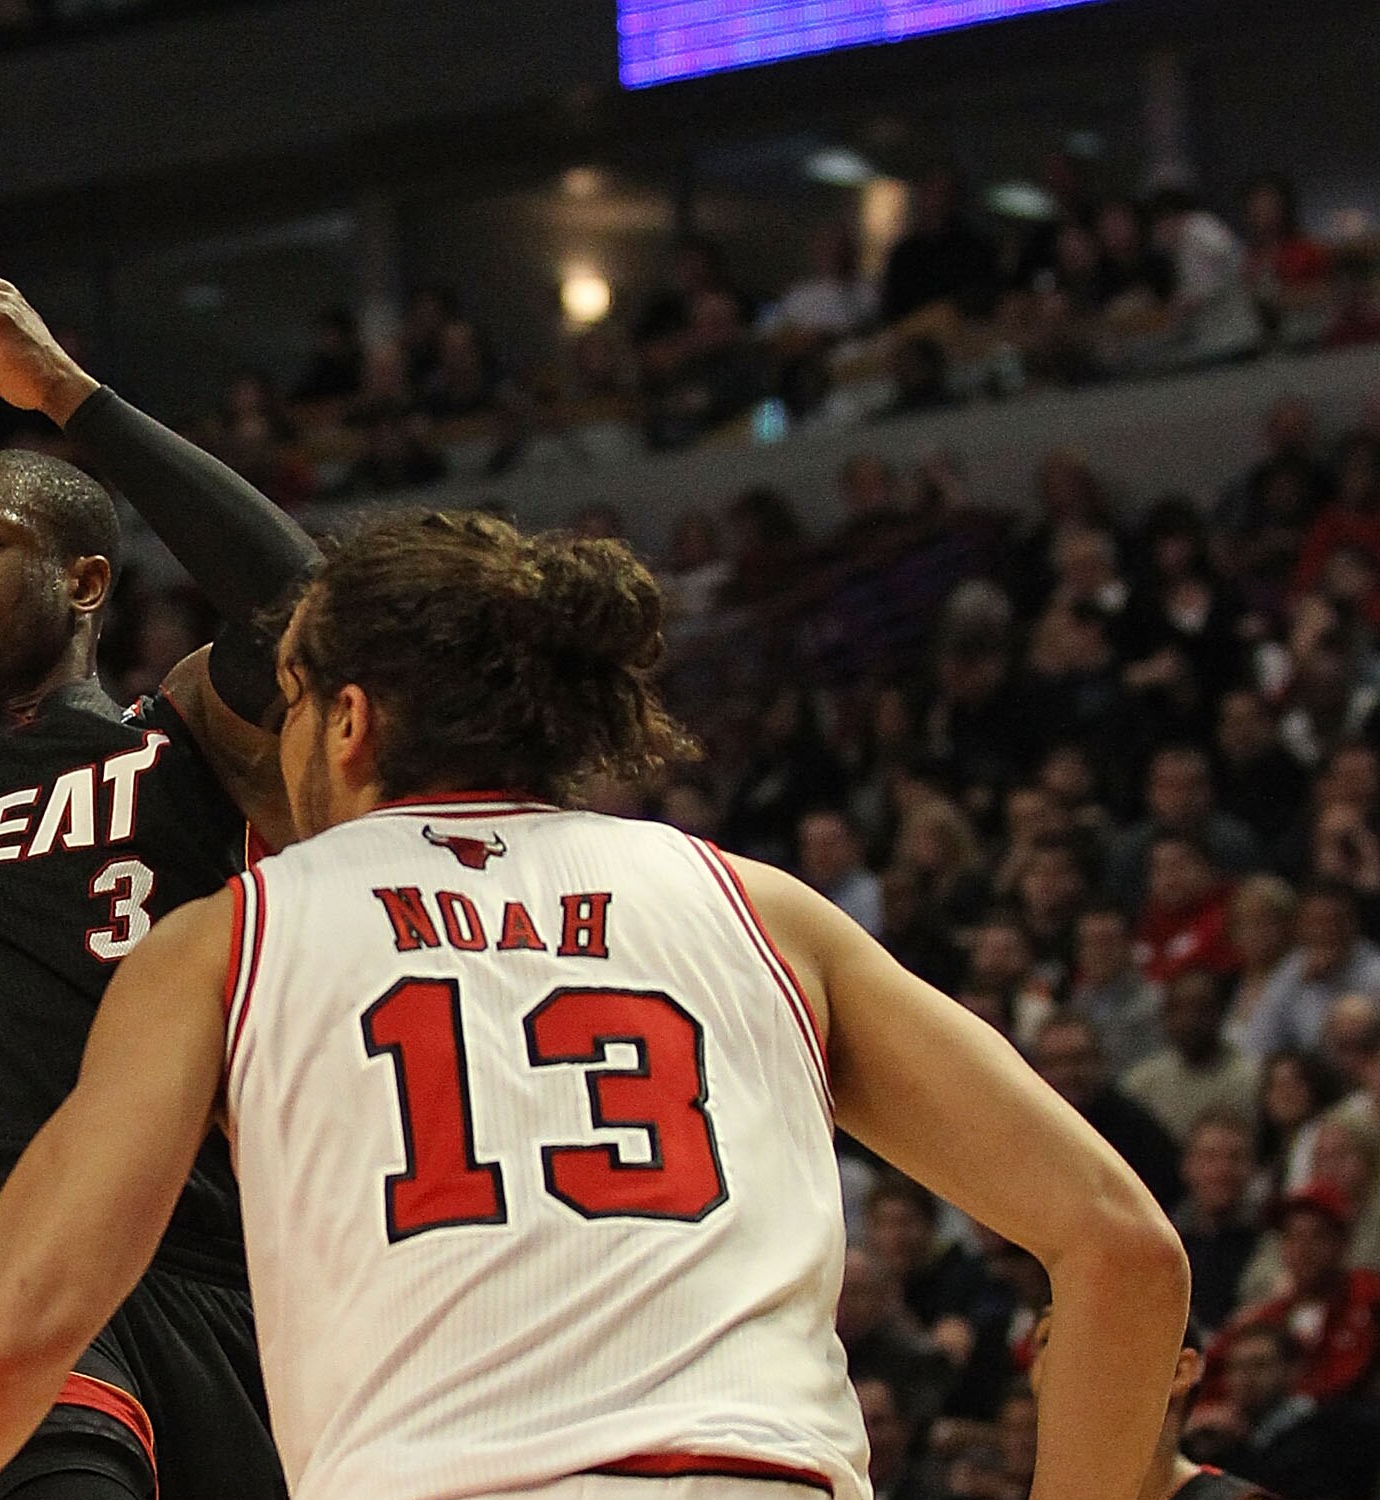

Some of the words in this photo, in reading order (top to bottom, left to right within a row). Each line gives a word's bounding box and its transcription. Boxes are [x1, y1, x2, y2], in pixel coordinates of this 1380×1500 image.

[85, 858, 156, 963] 3
[372, 886, 613, 959] NOAH
[359, 975, 731, 1245] 13
